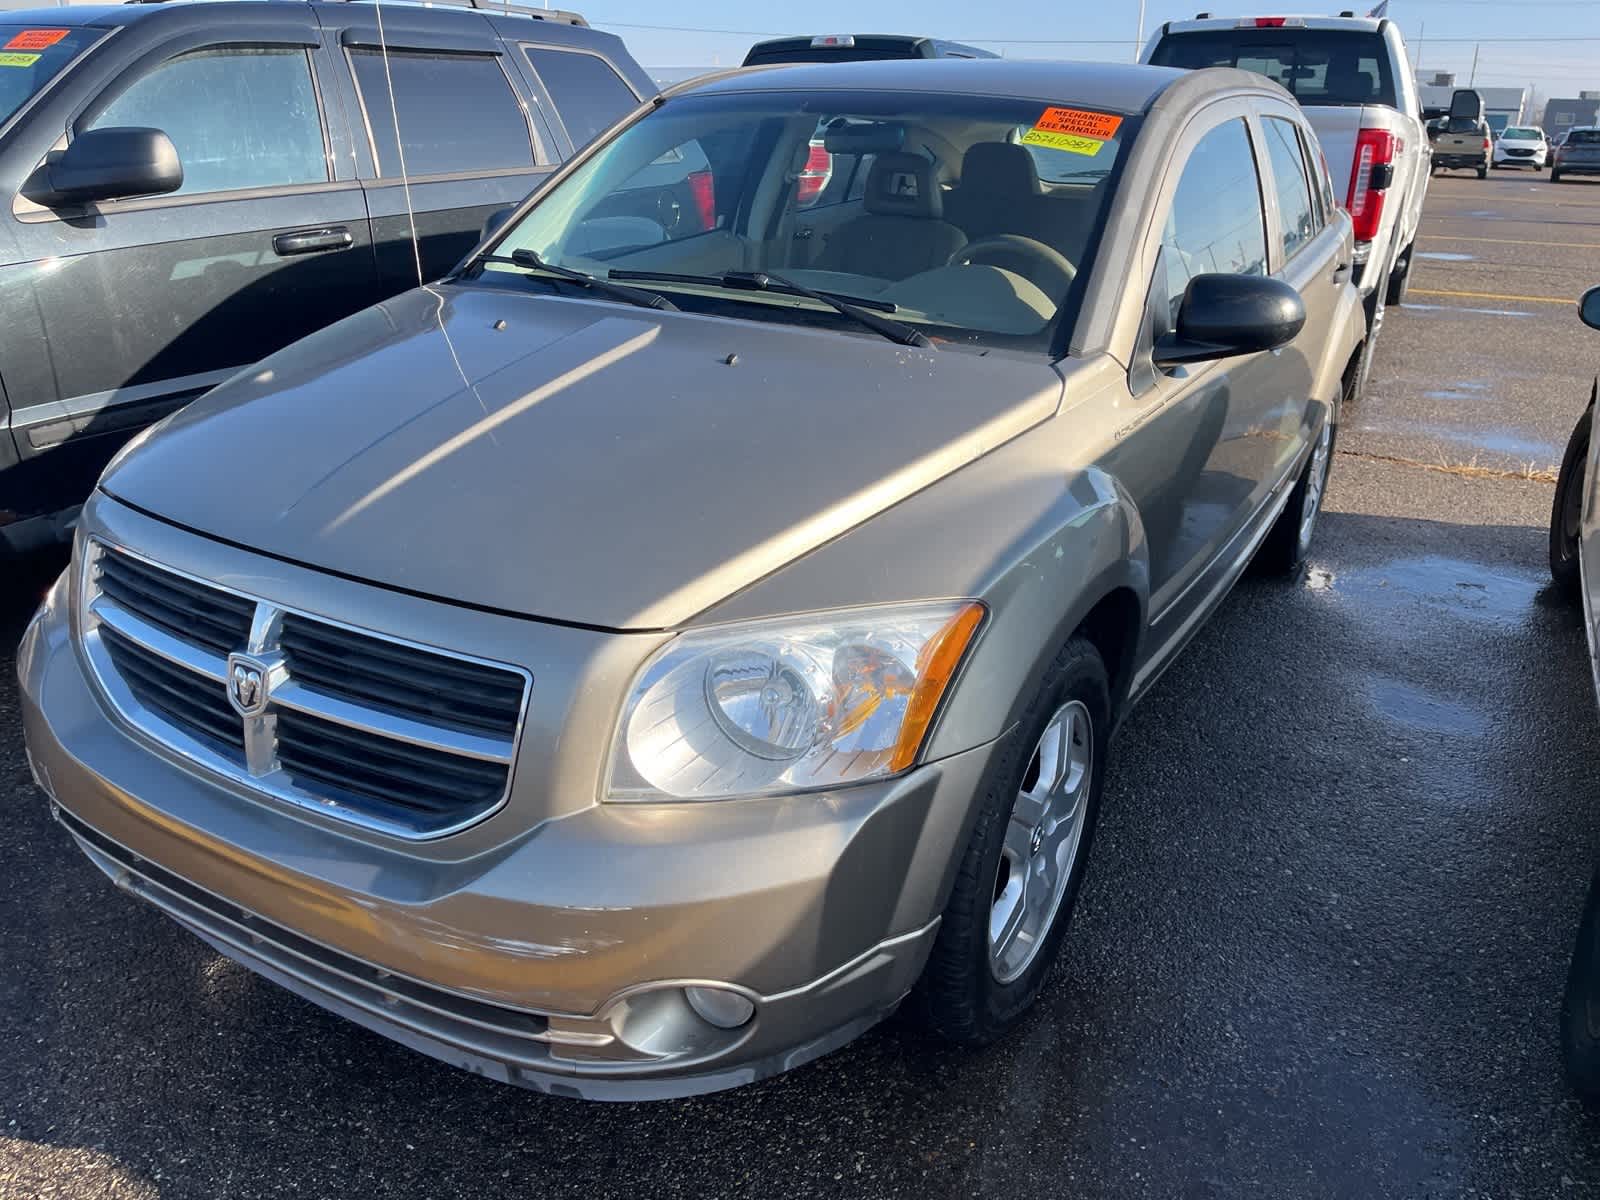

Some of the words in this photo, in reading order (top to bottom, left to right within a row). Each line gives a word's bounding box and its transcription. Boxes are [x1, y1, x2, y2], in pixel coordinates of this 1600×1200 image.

[1054, 110, 1112, 123] MECHANICS
[1058, 117, 1098, 127] SPECIAL
[1039, 121, 1057, 129] SEE
[1059, 124, 1111, 137] MANAGER
